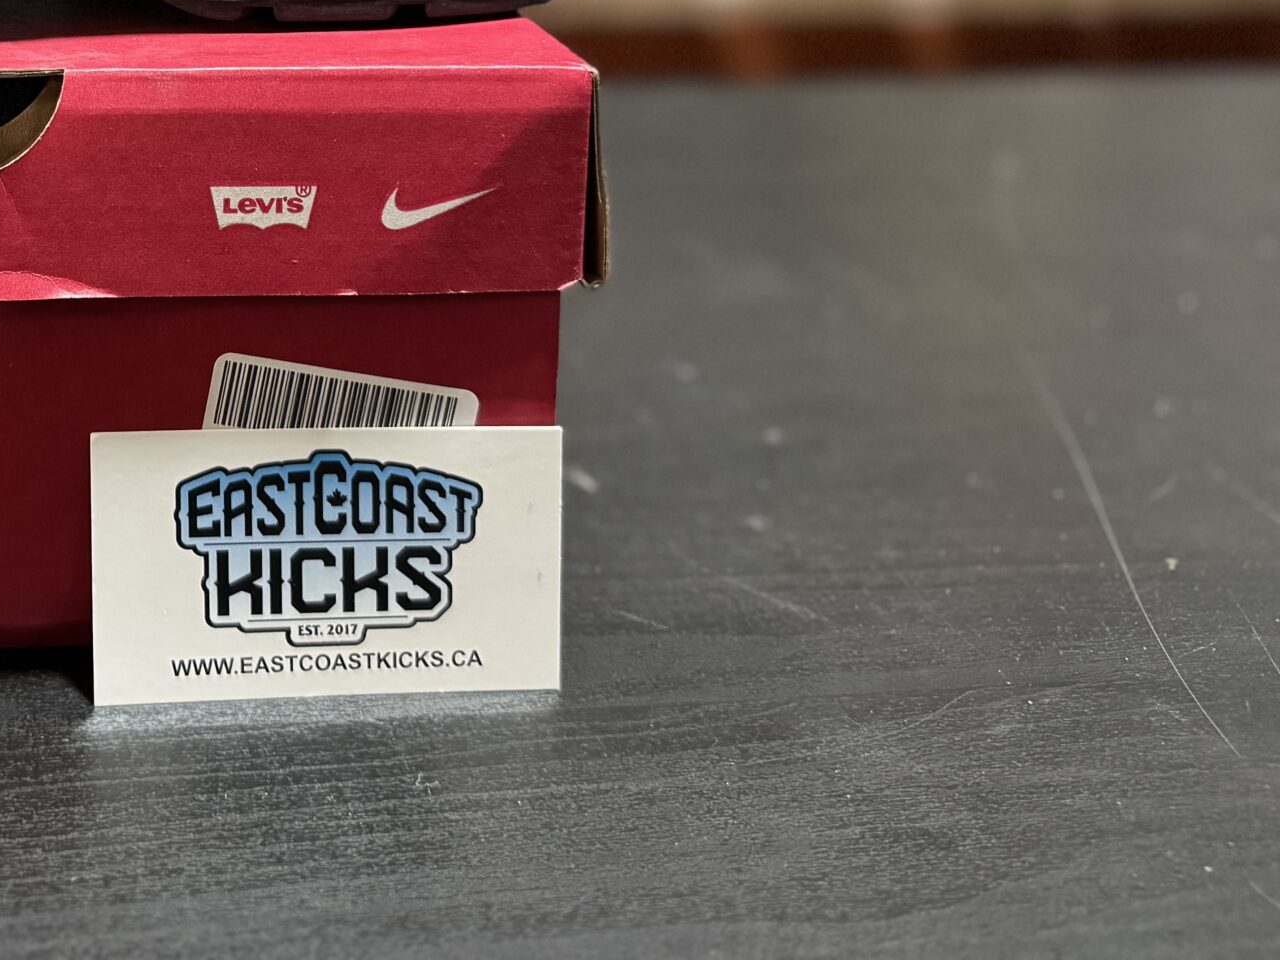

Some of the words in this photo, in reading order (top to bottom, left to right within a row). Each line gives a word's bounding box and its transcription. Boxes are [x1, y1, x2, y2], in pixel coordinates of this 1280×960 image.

[187, 460, 472, 538] EASTCOAST
[214, 545, 442, 616] KICKS
[298, 625, 323, 636] EST.
[327, 624, 358, 635] 2017
[171, 650, 483, 677] WWW.EASTCOASTKICKS.CA
